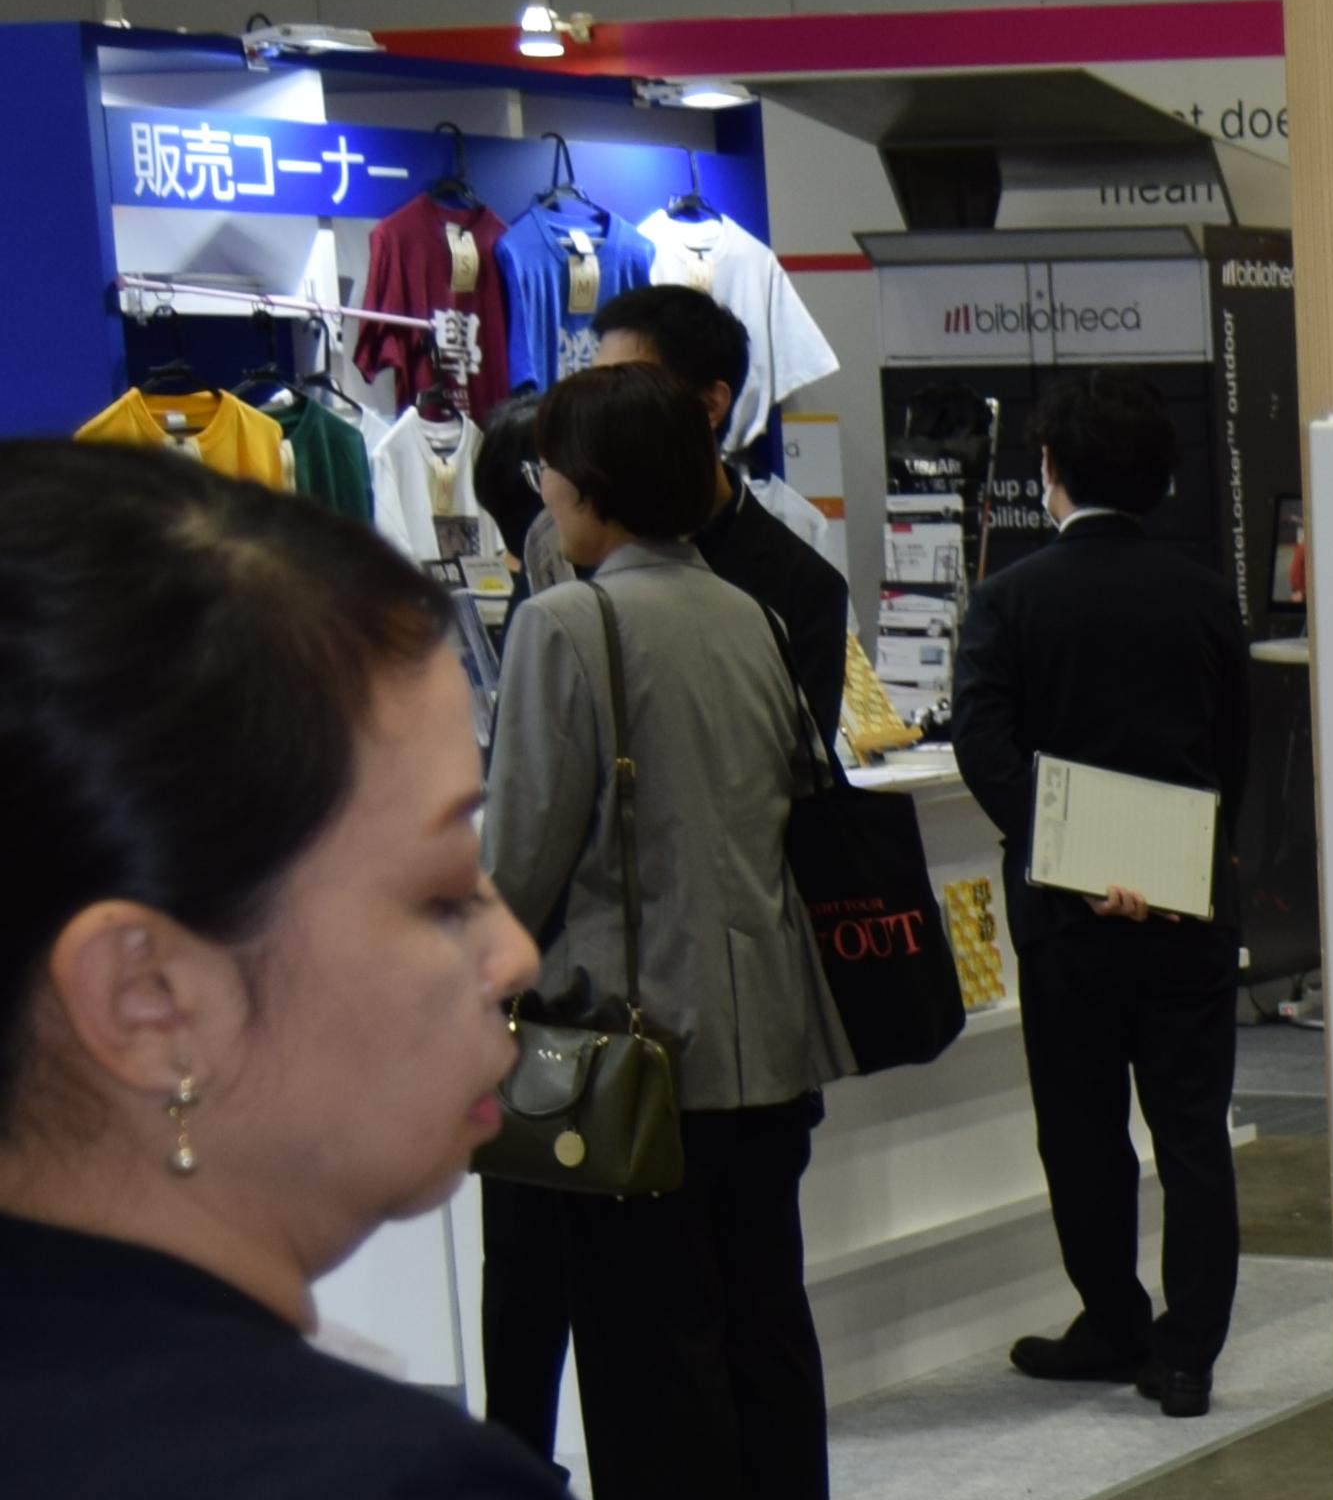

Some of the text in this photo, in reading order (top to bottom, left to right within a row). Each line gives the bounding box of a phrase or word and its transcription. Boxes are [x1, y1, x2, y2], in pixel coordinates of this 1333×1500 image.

[130, 122, 409, 204] 販売コーナー
[973, 301, 1142, 334] bibliotheca
[1223, 309, 1239, 414] outdoor
